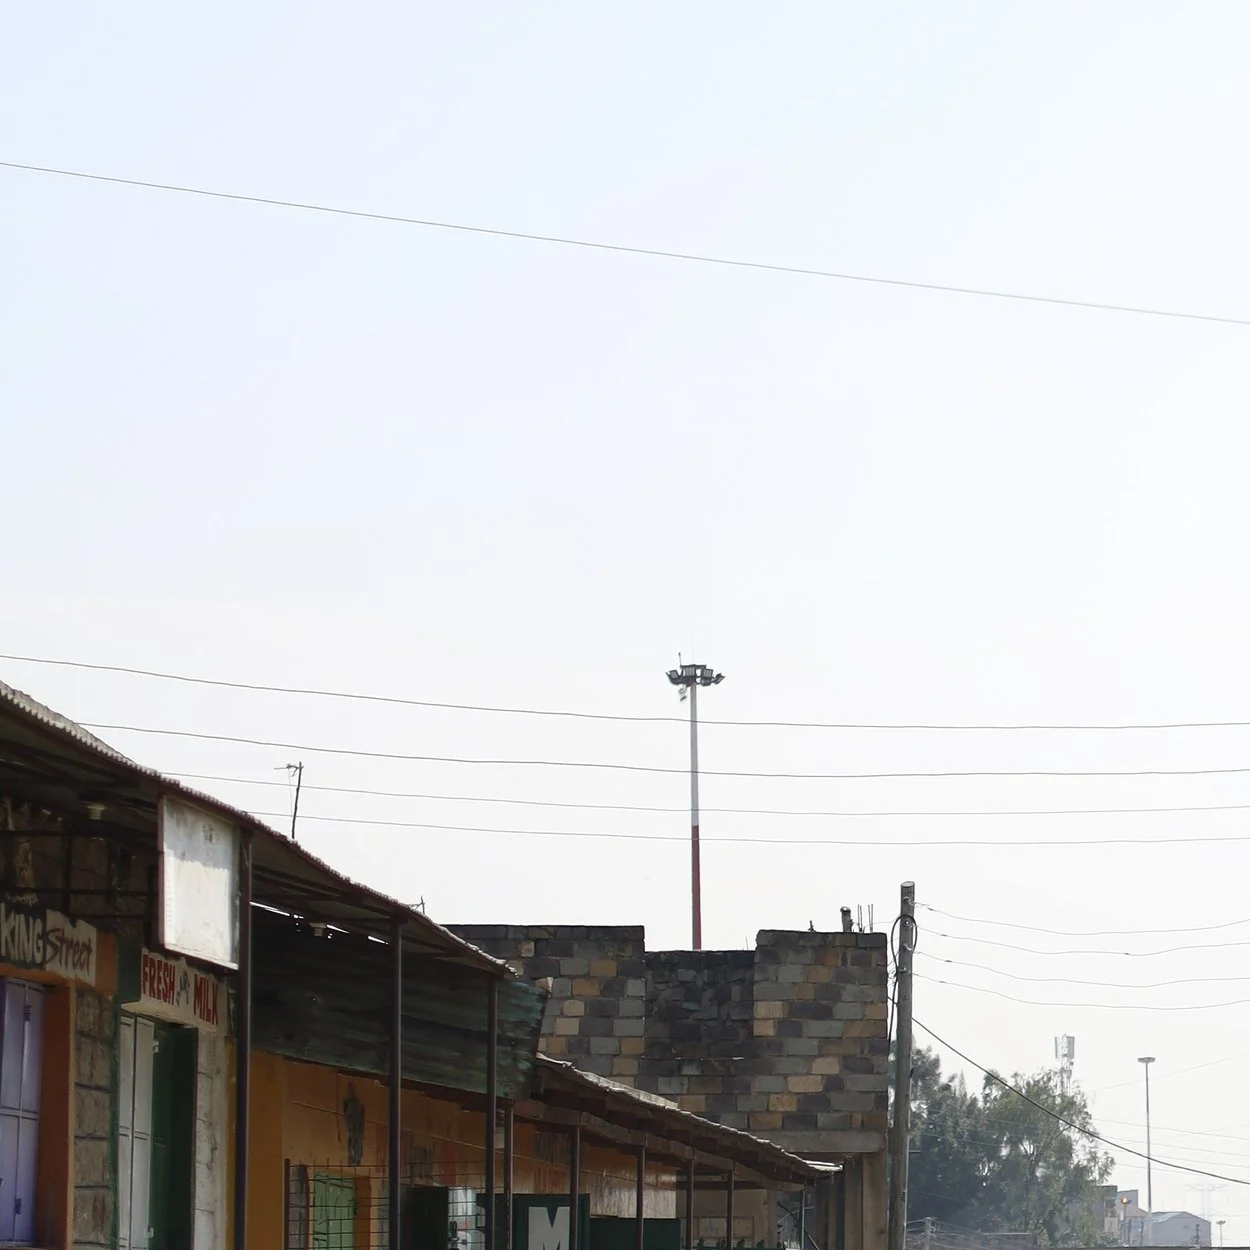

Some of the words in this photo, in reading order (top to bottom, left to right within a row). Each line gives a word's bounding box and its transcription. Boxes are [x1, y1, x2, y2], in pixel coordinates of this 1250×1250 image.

[46, 927, 93, 975] Street
[143, 954, 176, 1005] FRESH
[193, 974, 218, 1025] MILK
